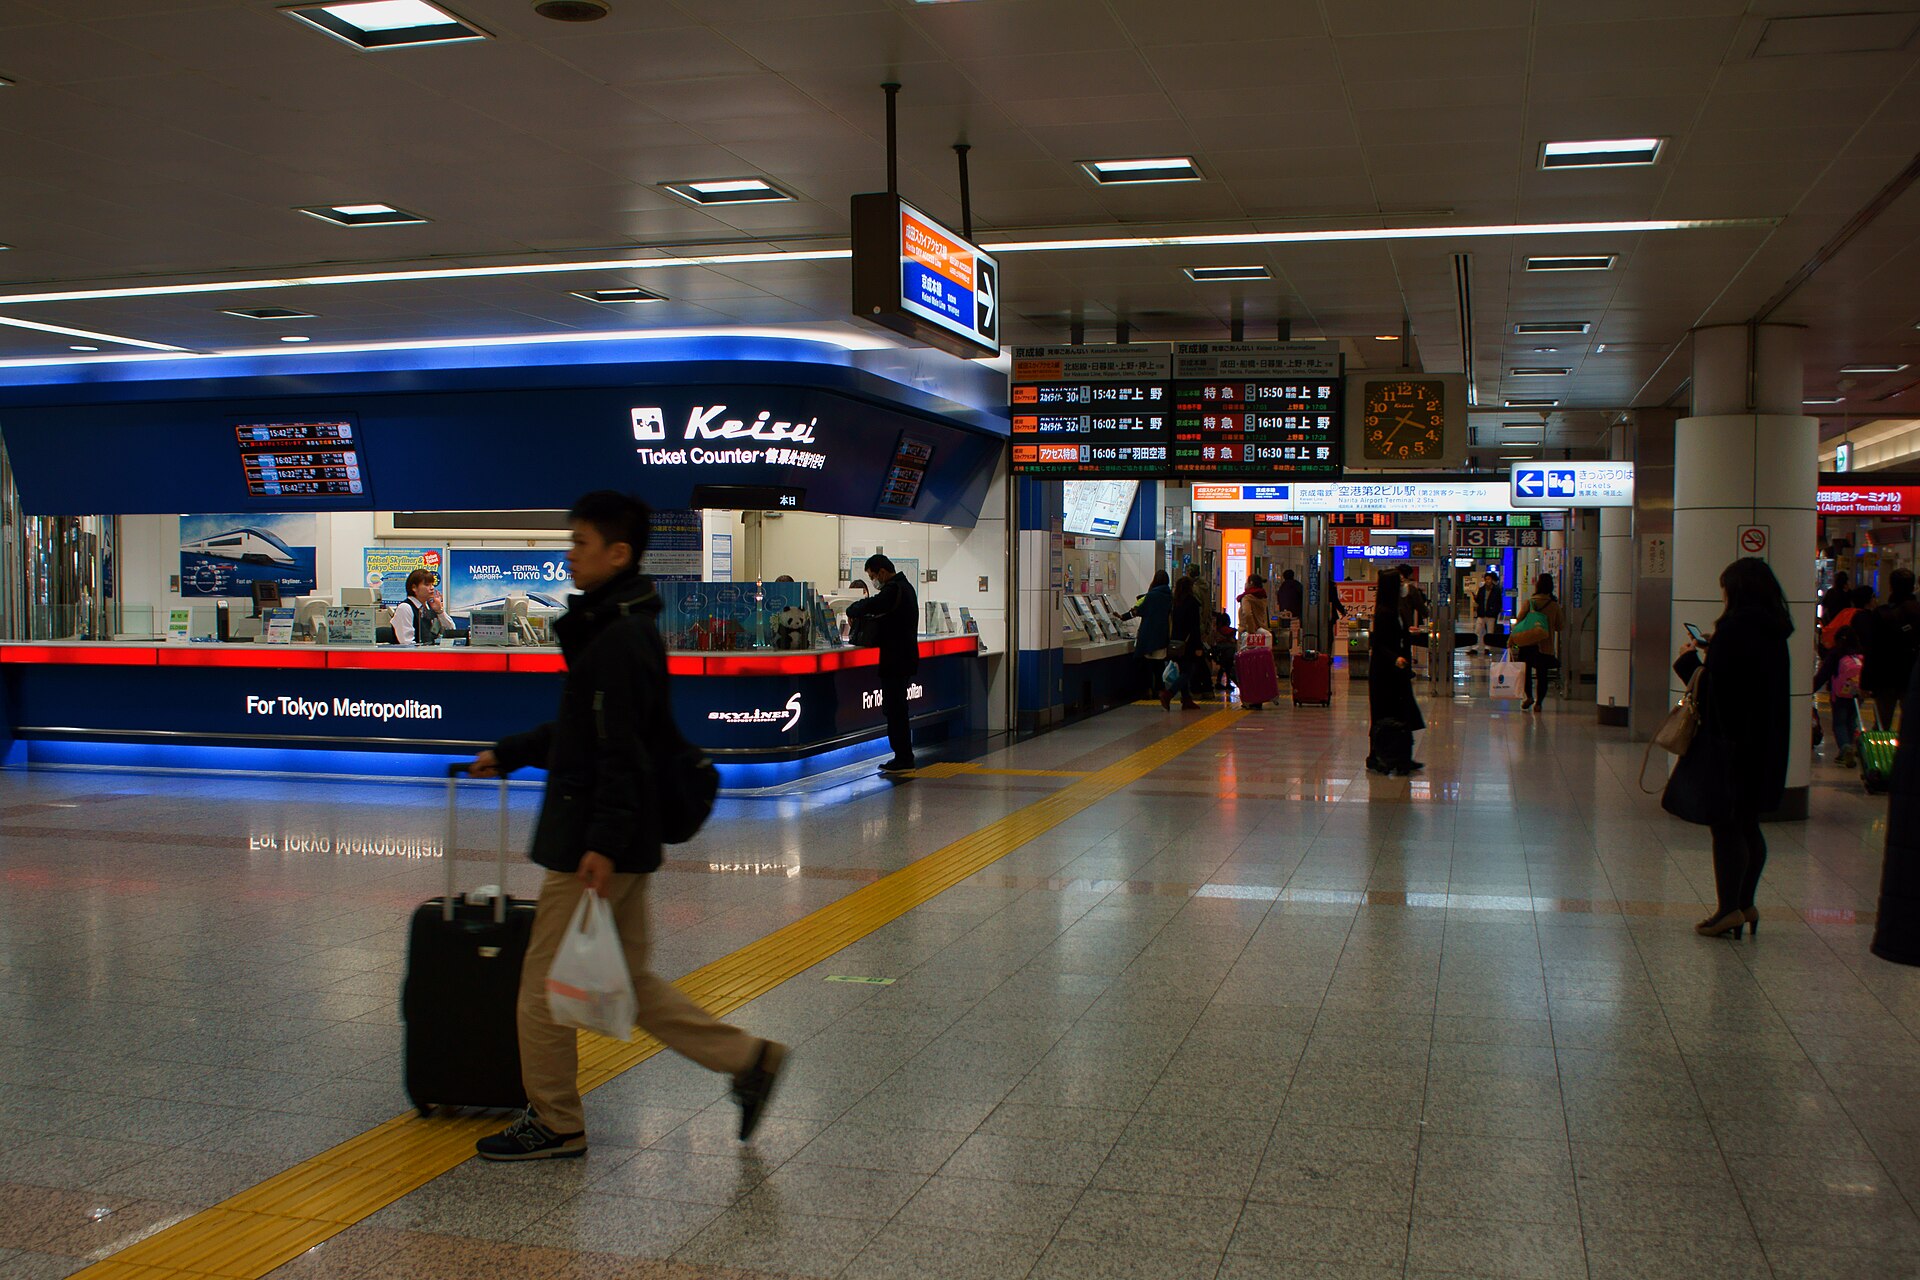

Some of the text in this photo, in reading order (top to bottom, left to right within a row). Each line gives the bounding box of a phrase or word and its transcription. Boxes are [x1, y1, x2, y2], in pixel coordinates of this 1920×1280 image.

[1093, 390, 1116, 400] 15:42
[1131, 387, 1162, 400] 上野
[1204, 387, 1234, 399] 特急
[1248, 386, 1253, 394] 3
[1258, 388, 1282, 398] 15:50
[1298, 385, 1331, 399] 上野
[1398, 386, 1412, 395] 12
[1418, 390, 1423, 400] 1
[1384, 392, 1396, 401] 11
[1374, 403, 1387, 412] 10
[1426, 401, 1436, 411] 2
[684, 405, 817, 443] Keisei
[1093, 419, 1116, 429] 16:02
[1131, 417, 1162, 430] 上野
[1204, 417, 1233, 429] 特急
[1247, 416, 1253, 424] 3
[1258, 418, 1282, 428] 16:10
[1298, 416, 1330, 429] 上野
[1369, 416, 1379, 426] 9
[1431, 415, 1440, 425] 3
[270, 429, 287, 437] 15:42
[1373, 430, 1383, 440] 8
[1426, 430, 1434, 440] 4
[1386, 442, 1393, 452] 7
[1399, 446, 1409, 456] 6
[1414, 442, 1424, 451] 5
[637, 448, 687, 464] Ticket
[690, 447, 759, 464] Counter
[1040, 448, 1077, 459] アクセス特急
[1092, 448, 1116, 459] 16:06
[1132, 447, 1166, 460] 羽田空港
[1203, 447, 1233, 459] 特急
[1246, 446, 1252, 455] 3
[1257, 448, 1282, 458] 16:30
[1297, 446, 1330, 459] 上野
[281, 484, 299, 492] 16:42
[1300, 489, 1333, 497] 京成電鉄
[1339, 485, 1415, 496] 空港第2ビル駅
[780, 495, 795, 505] 本日
[1822, 503, 1901, 512] (Airport Terminal 2)
[470, 565, 501, 574] NARITA
[512, 572, 540, 580] TOKYO
[863, 691, 874, 709] For
[247, 696, 442, 722] For Tokyo Metropolitan
[708, 708, 789, 719] SKYLINER
